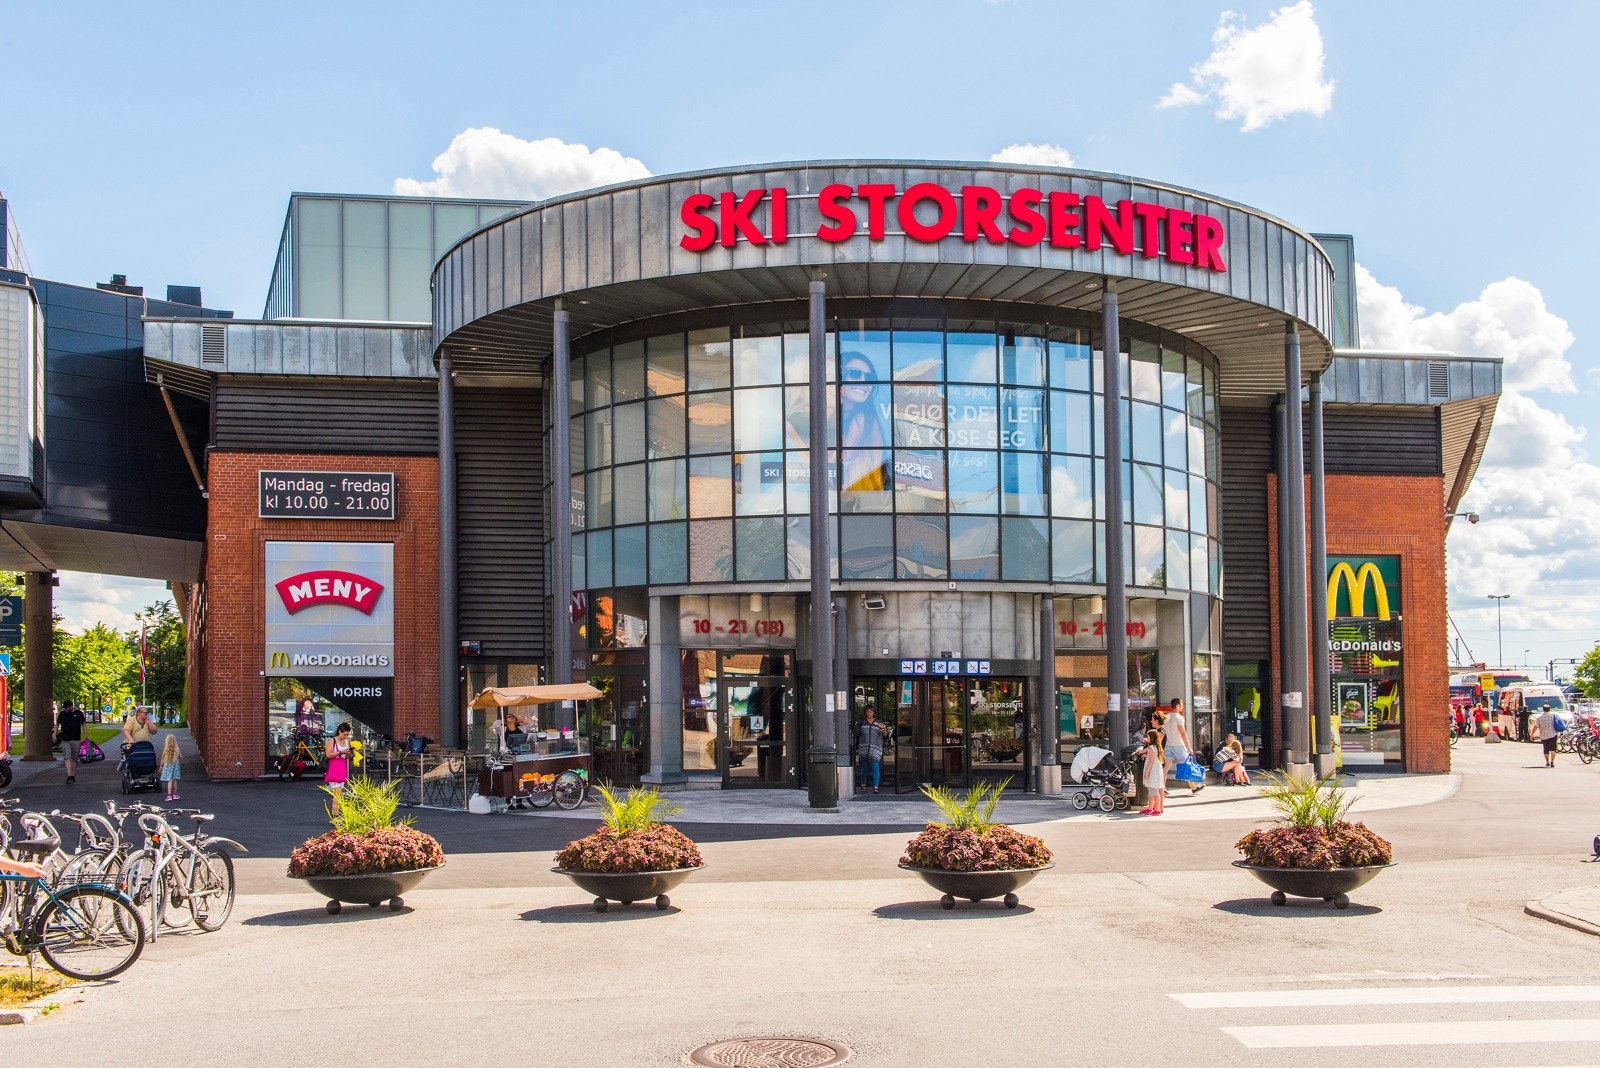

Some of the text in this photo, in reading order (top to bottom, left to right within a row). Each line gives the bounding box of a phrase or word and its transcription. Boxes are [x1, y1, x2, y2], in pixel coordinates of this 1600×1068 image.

[679, 182, 1227, 272] SKI STORSENTER
[905, 403, 957, 421] GIØR
[963, 405, 1001, 422] DET
[908, 422, 1026, 447] Å KOSE SEG
[764, 468, 779, 477] SKI
[265, 477, 324, 494] Mandag
[342, 478, 390, 495] fredag
[265, 495, 278, 508] kl
[285, 496, 328, 509] 10.00
[346, 497, 389, 510] 21.00
[288, 578, 372, 603] MENY
[693, 619, 711, 634] 10
[728, 619, 748, 634] 21
[755, 619, 784, 637] (18)
[1060, 621, 1078, 635] 10
[1093, 621, 1107, 635] 2
[293, 653, 389, 666] McDonald's
[333, 687, 383, 697] MORRIS
